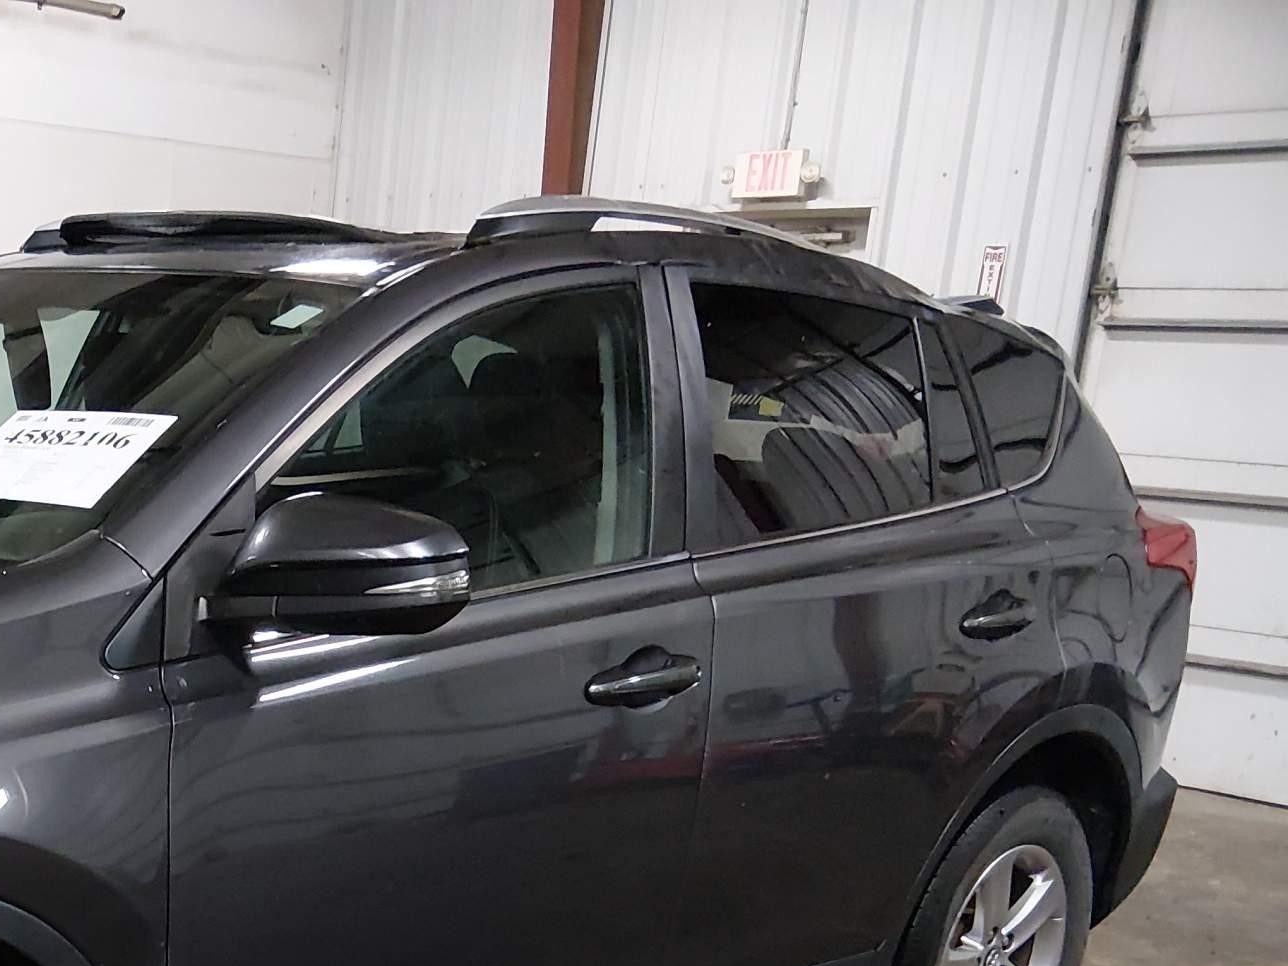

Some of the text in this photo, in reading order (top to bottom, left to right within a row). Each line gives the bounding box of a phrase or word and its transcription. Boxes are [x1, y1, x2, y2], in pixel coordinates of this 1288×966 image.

[745, 151, 792, 192] EXIT
[984, 252, 1004, 262] FIRE
[4, 428, 137, 450] 45882106
